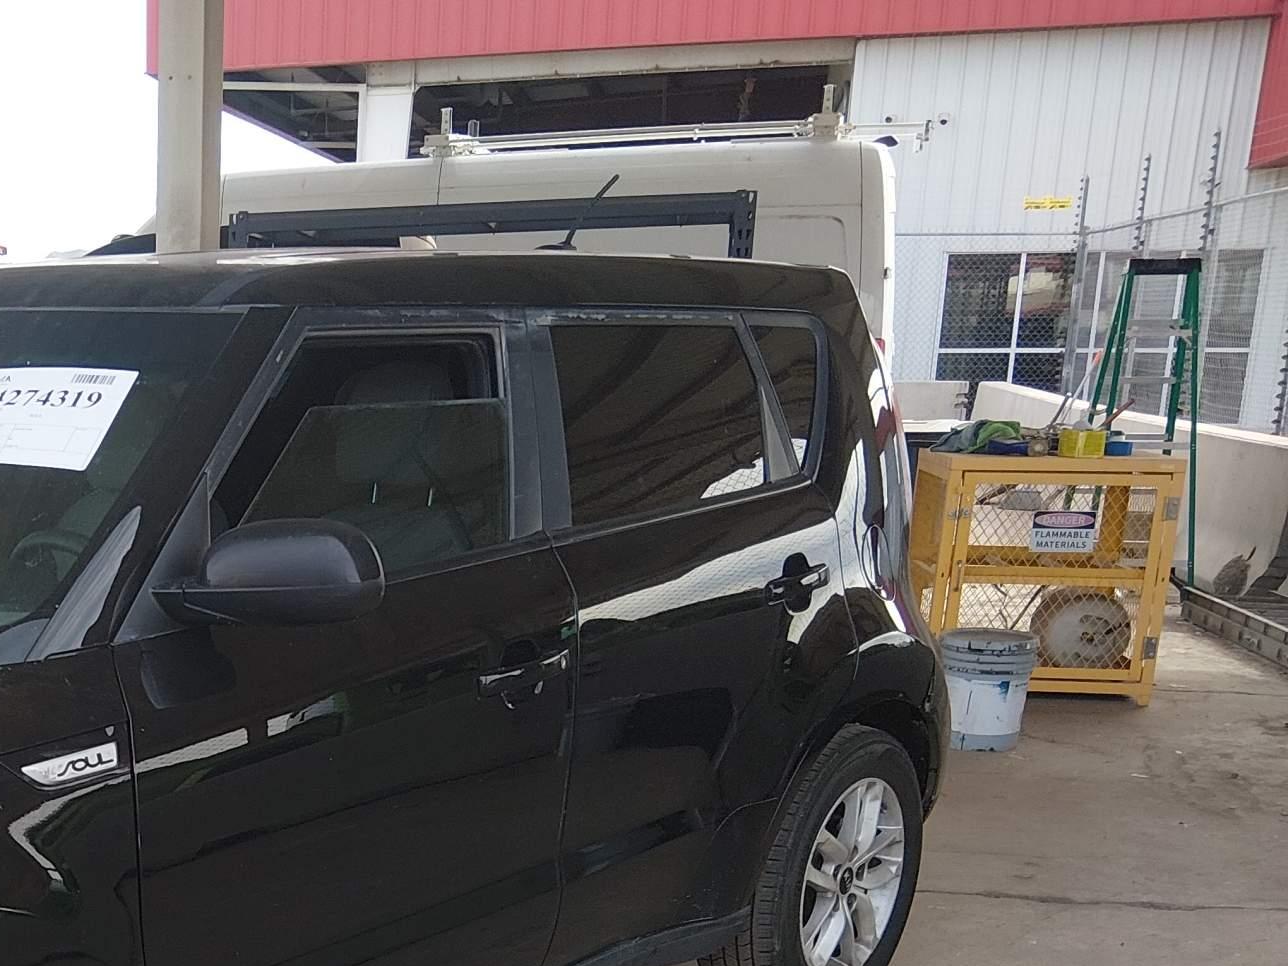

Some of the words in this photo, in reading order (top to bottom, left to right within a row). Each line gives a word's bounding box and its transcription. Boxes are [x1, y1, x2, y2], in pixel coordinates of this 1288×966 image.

[1040, 514, 1086, 525] DANGER
[1034, 530, 1091, 539] FLAMMABLE
[1035, 540, 1087, 549] MATERIALS
